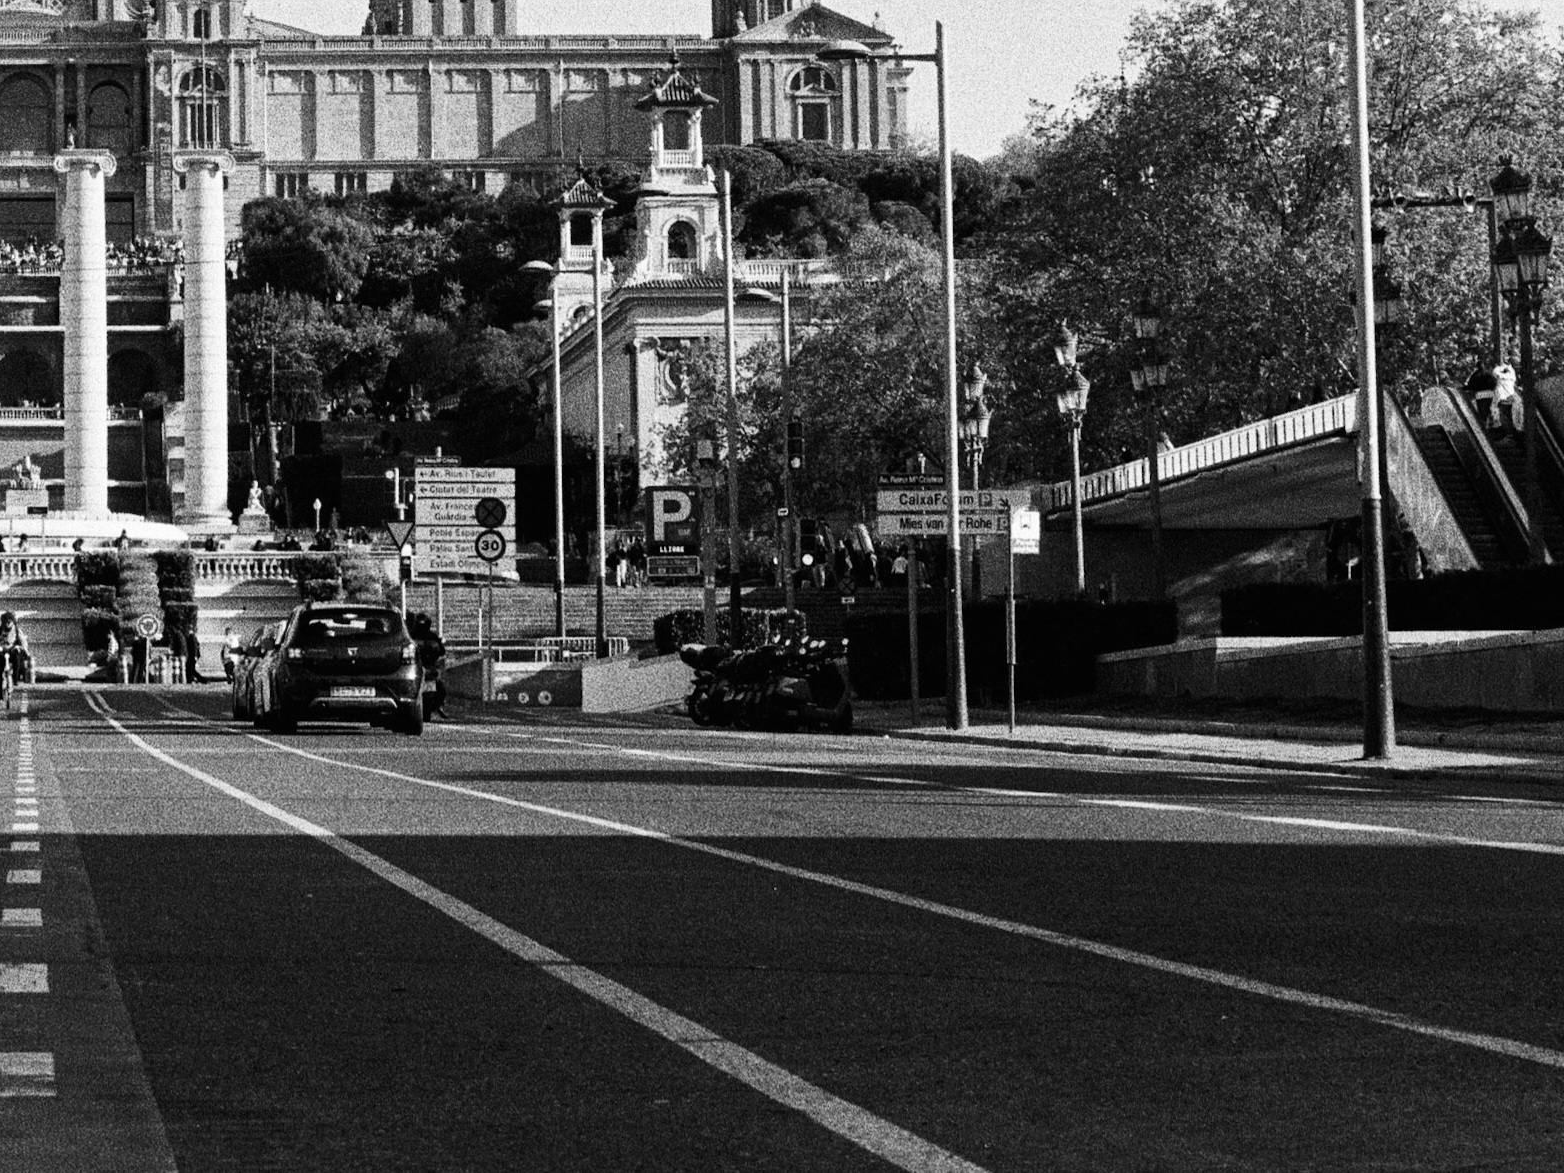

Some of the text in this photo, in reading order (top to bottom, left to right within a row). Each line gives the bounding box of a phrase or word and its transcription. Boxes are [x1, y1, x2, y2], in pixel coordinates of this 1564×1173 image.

[429, 470, 443, 478] Av.
[429, 485, 497, 494] Ciutat del Teatre
[430, 502, 443, 510] Av.
[653, 490, 692, 541] P
[899, 517, 923, 529] Mies
[925, 519, 944, 529] van
[966, 517, 992, 529] Rohe
[429, 528, 453, 537] Poble
[429, 544, 474, 553] Palau Sant
[481, 540, 499, 551] 30
